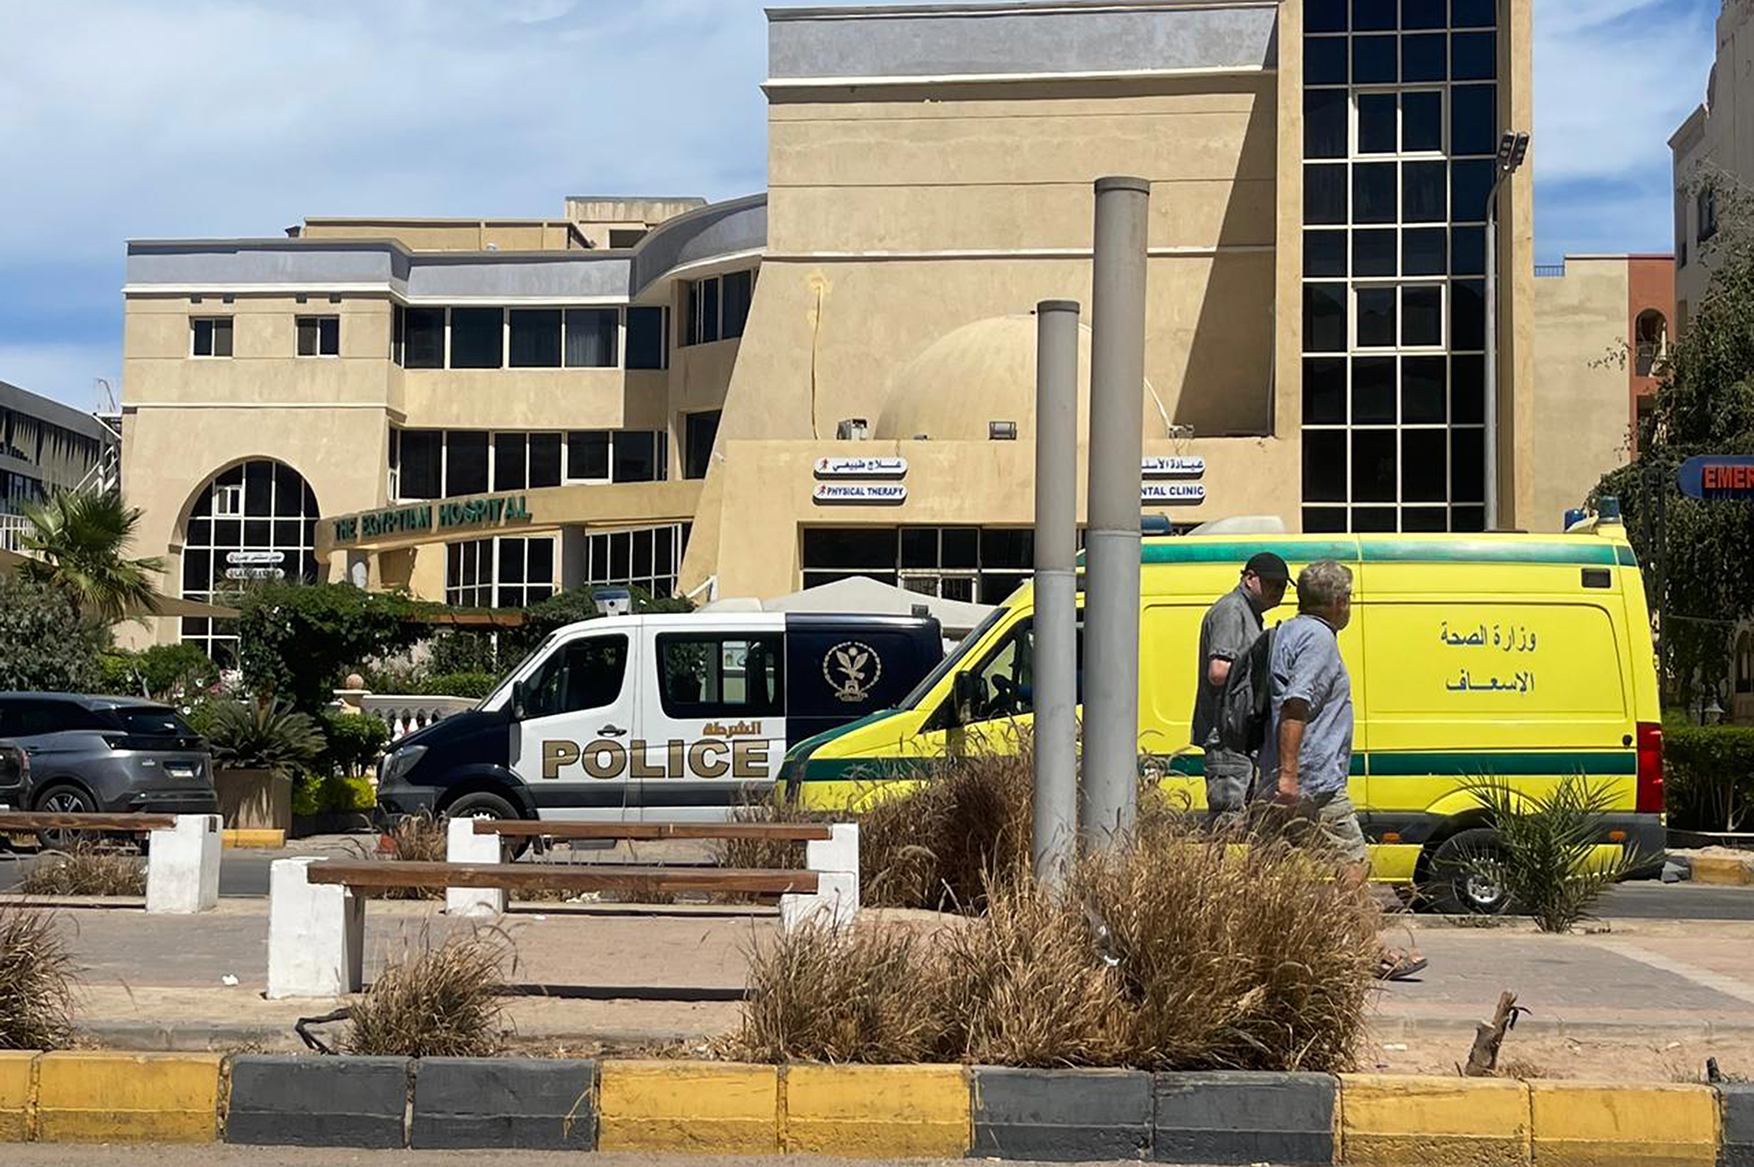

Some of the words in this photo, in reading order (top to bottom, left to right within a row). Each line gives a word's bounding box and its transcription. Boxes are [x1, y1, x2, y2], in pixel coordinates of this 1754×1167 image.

[827, 487, 865, 496] PHYSICAL
[867, 487, 903, 496] THERAPY
[1169, 486, 1204, 496] CLINIC
[333, 517, 358, 541] THE
[361, 504, 433, 537] EGYPTIAN
[438, 495, 529, 527] HOSPITAL
[1441, 621, 1488, 646] الصحة
[1494, 624, 1536, 652] وزارة
[703, 720, 762, 739] الشرطة
[542, 739, 770, 779] POLICE
